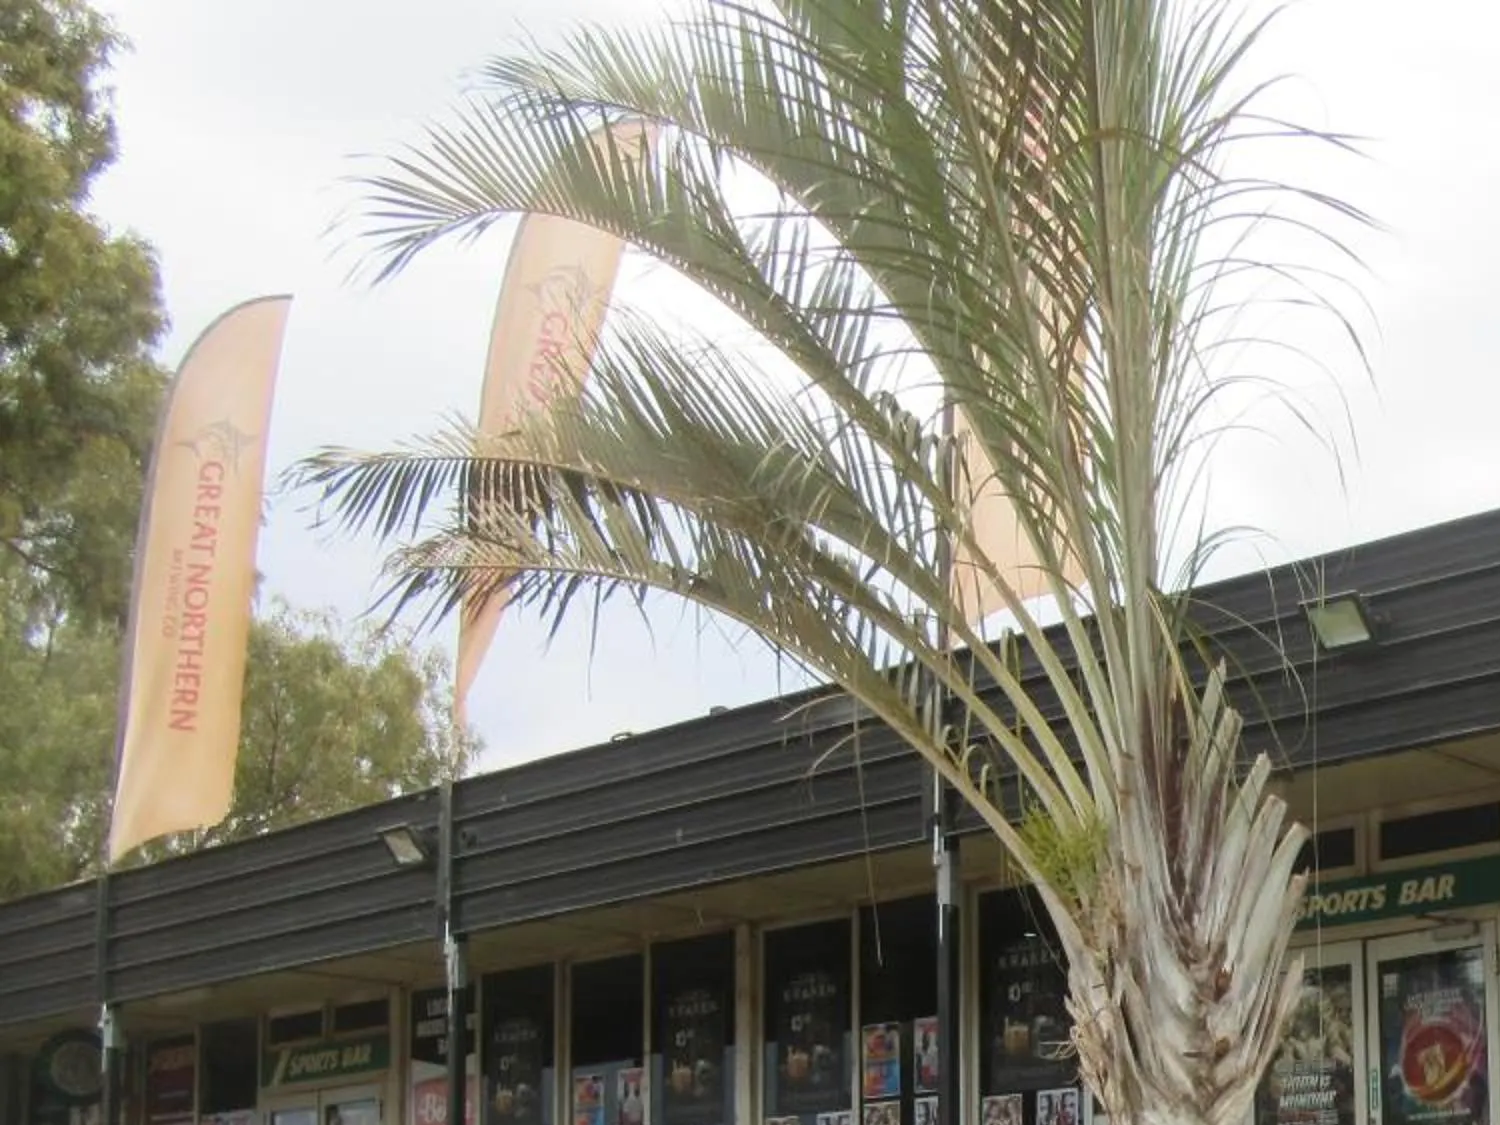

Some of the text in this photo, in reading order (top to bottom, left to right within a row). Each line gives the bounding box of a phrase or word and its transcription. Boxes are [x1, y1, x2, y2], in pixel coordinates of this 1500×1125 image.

[168, 460, 225, 733] GREAT NORTHERN
[1293, 874, 1456, 920] SPORTS BAR
